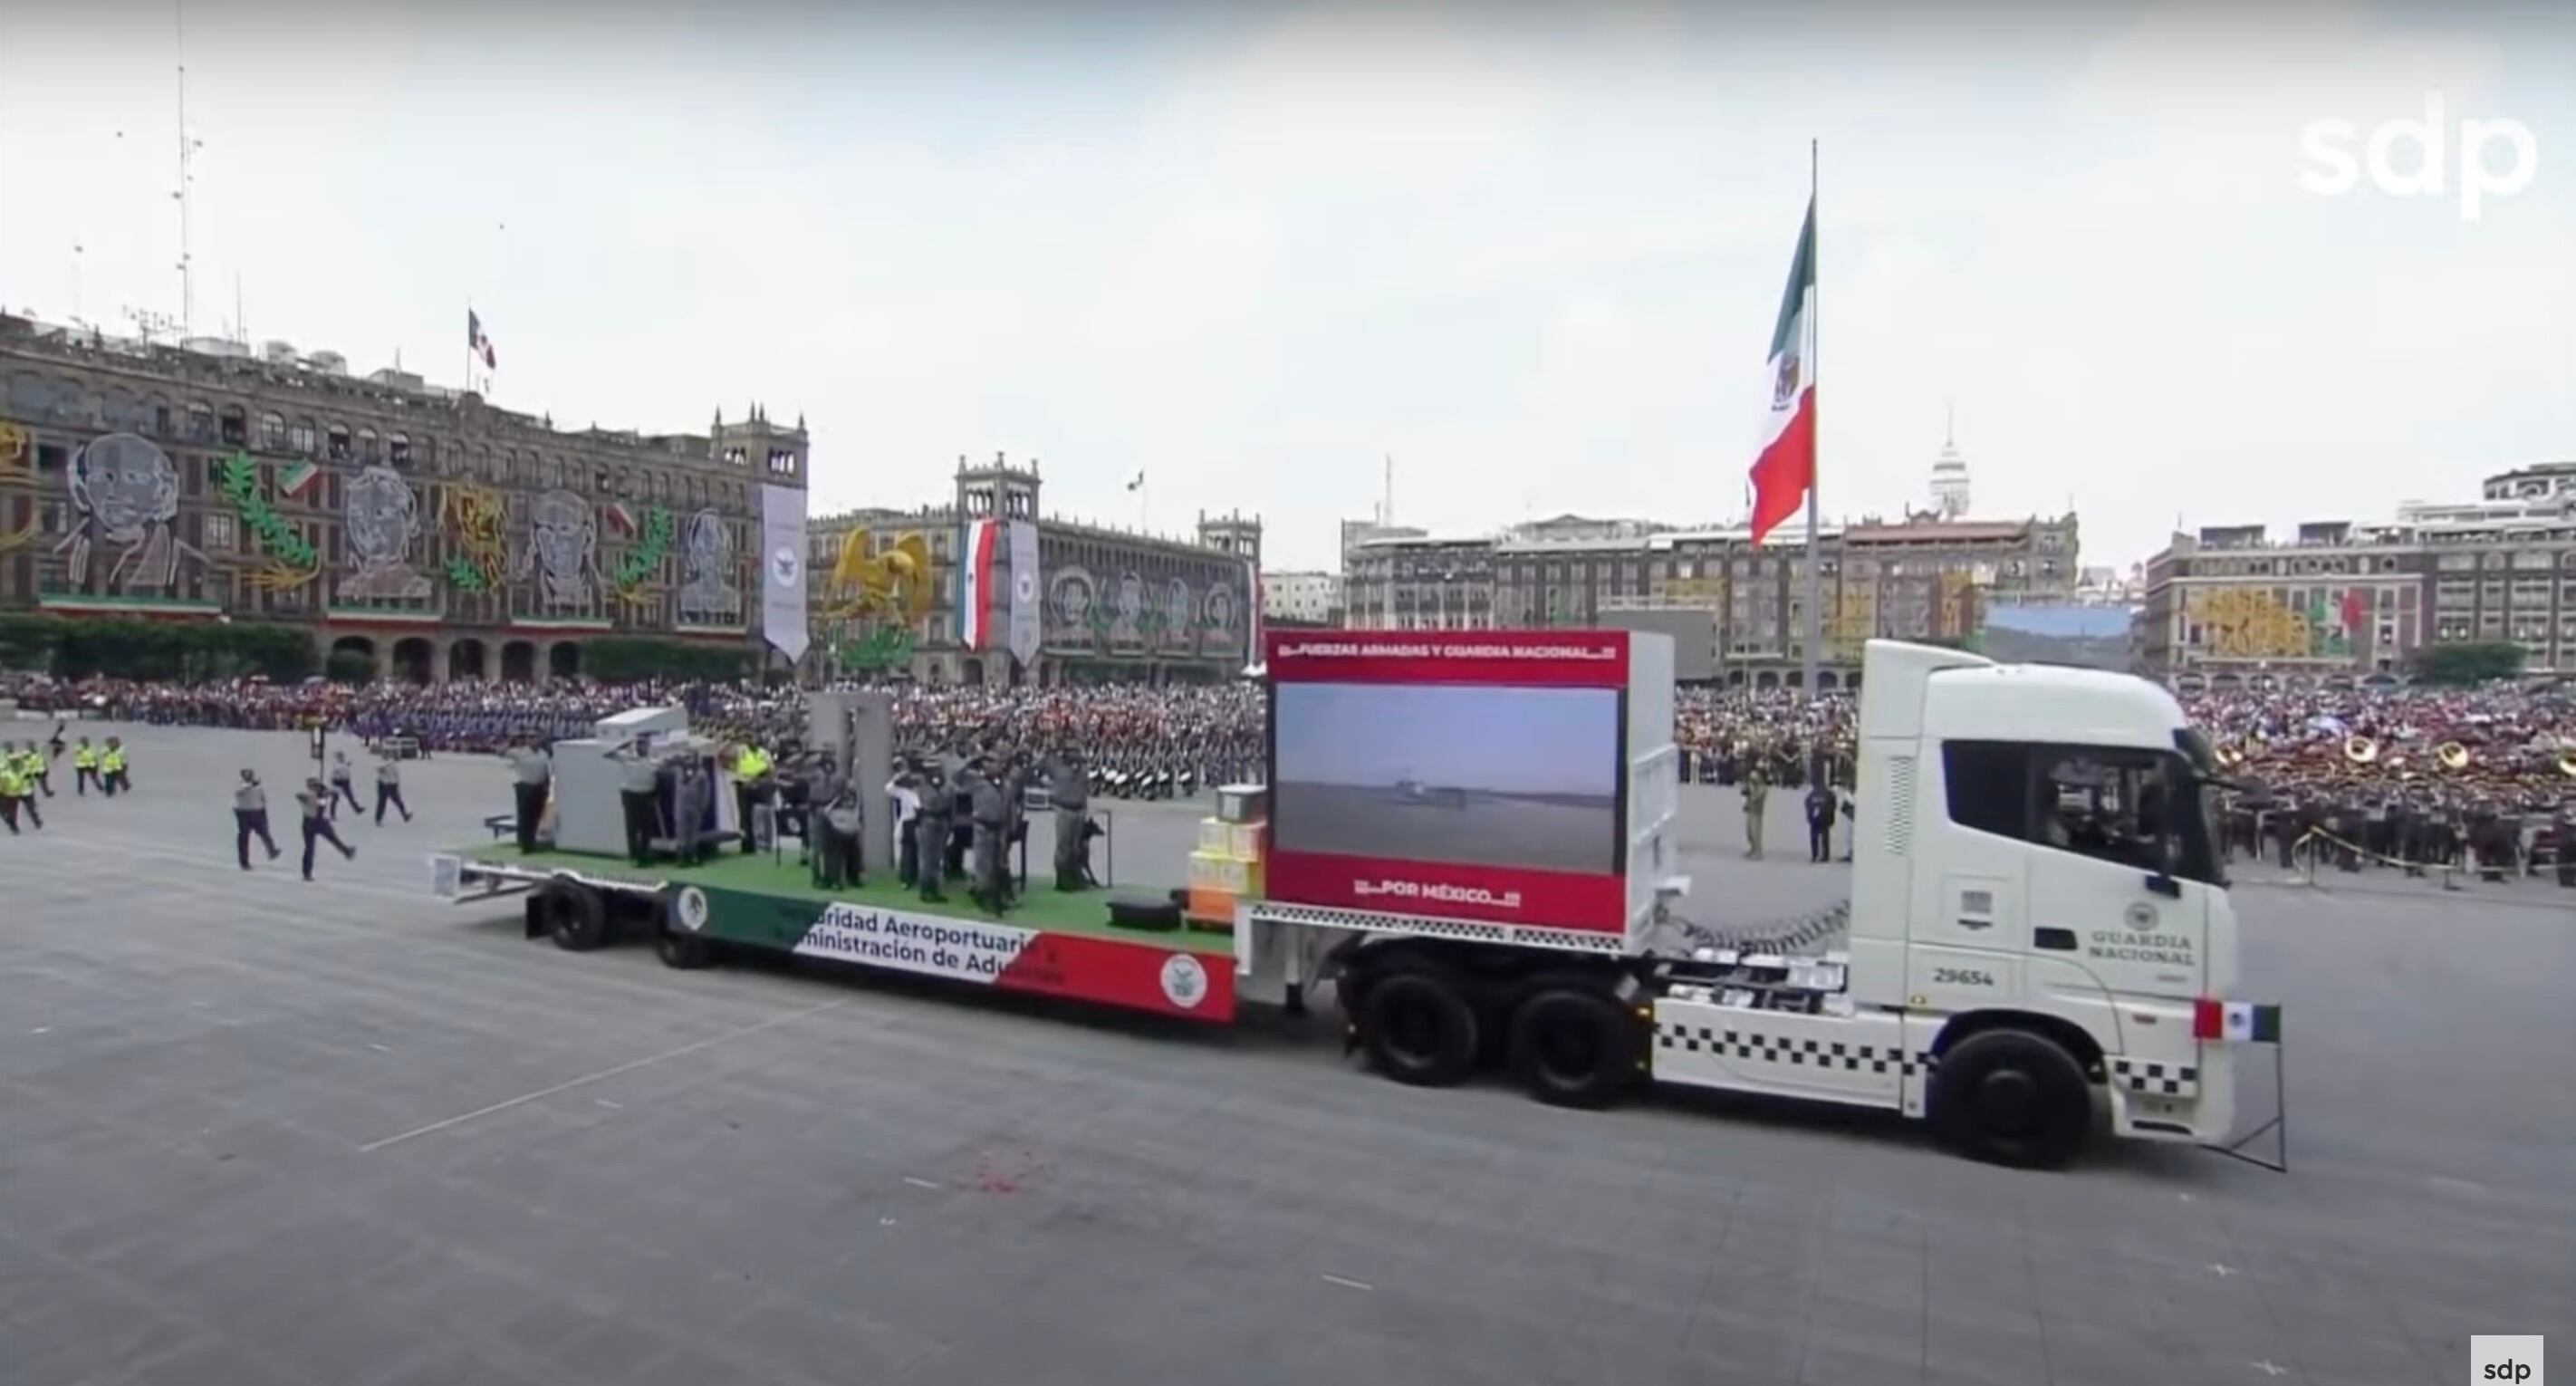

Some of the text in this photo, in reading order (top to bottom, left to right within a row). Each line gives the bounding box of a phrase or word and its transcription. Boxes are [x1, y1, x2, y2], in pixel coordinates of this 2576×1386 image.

[1360, 644, 1429, 658] ARMADAS
[1431, 644, 1442, 658] Y
[1443, 645, 1511, 659] GUARDIA
[884, 915, 1035, 952] Aeroportuari
[2091, 930, 2192, 950] GUARDIA
[776, 925, 926, 964] ministración
[932, 949, 959, 969] de
[2088, 946, 2196, 967] NACIONAL
[1933, 967, 1994, 987] 29654
